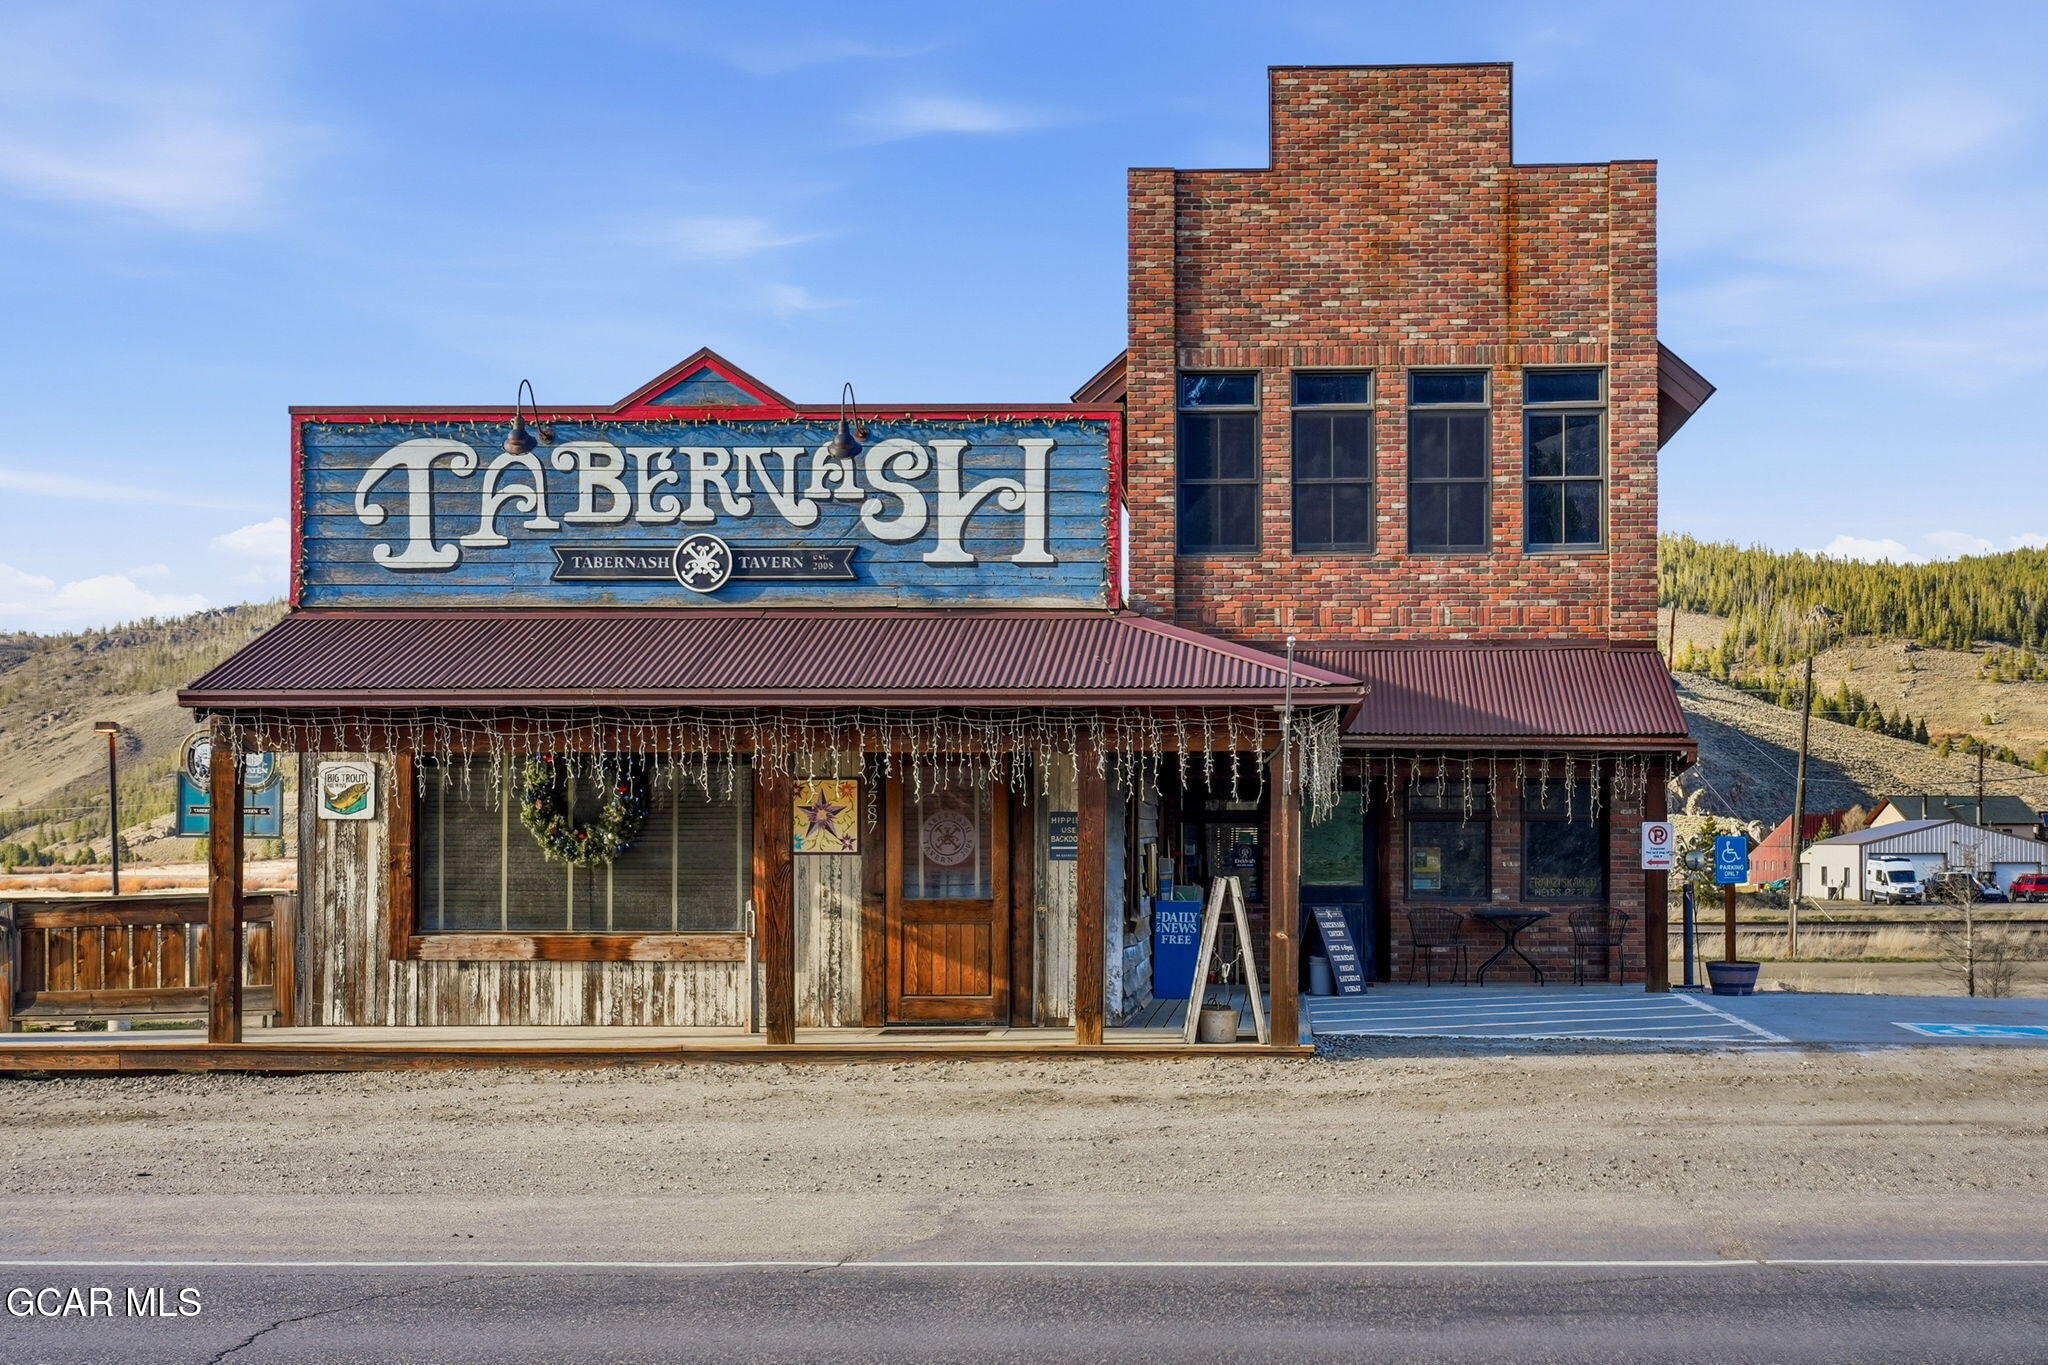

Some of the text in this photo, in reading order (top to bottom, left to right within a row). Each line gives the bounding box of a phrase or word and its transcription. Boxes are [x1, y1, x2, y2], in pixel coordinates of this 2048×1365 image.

[354, 437, 1055, 569] TABERNASH
[571, 555, 803, 569] TABERNASH TAVERN
[327, 773, 365, 783] BIG TROUT
[1050, 835, 1078, 843] BACKDO
[1161, 911, 1198, 923] DAILY
[1160, 922, 1197, 934] NEWS
[1161, 934, 1192, 945] FREE
